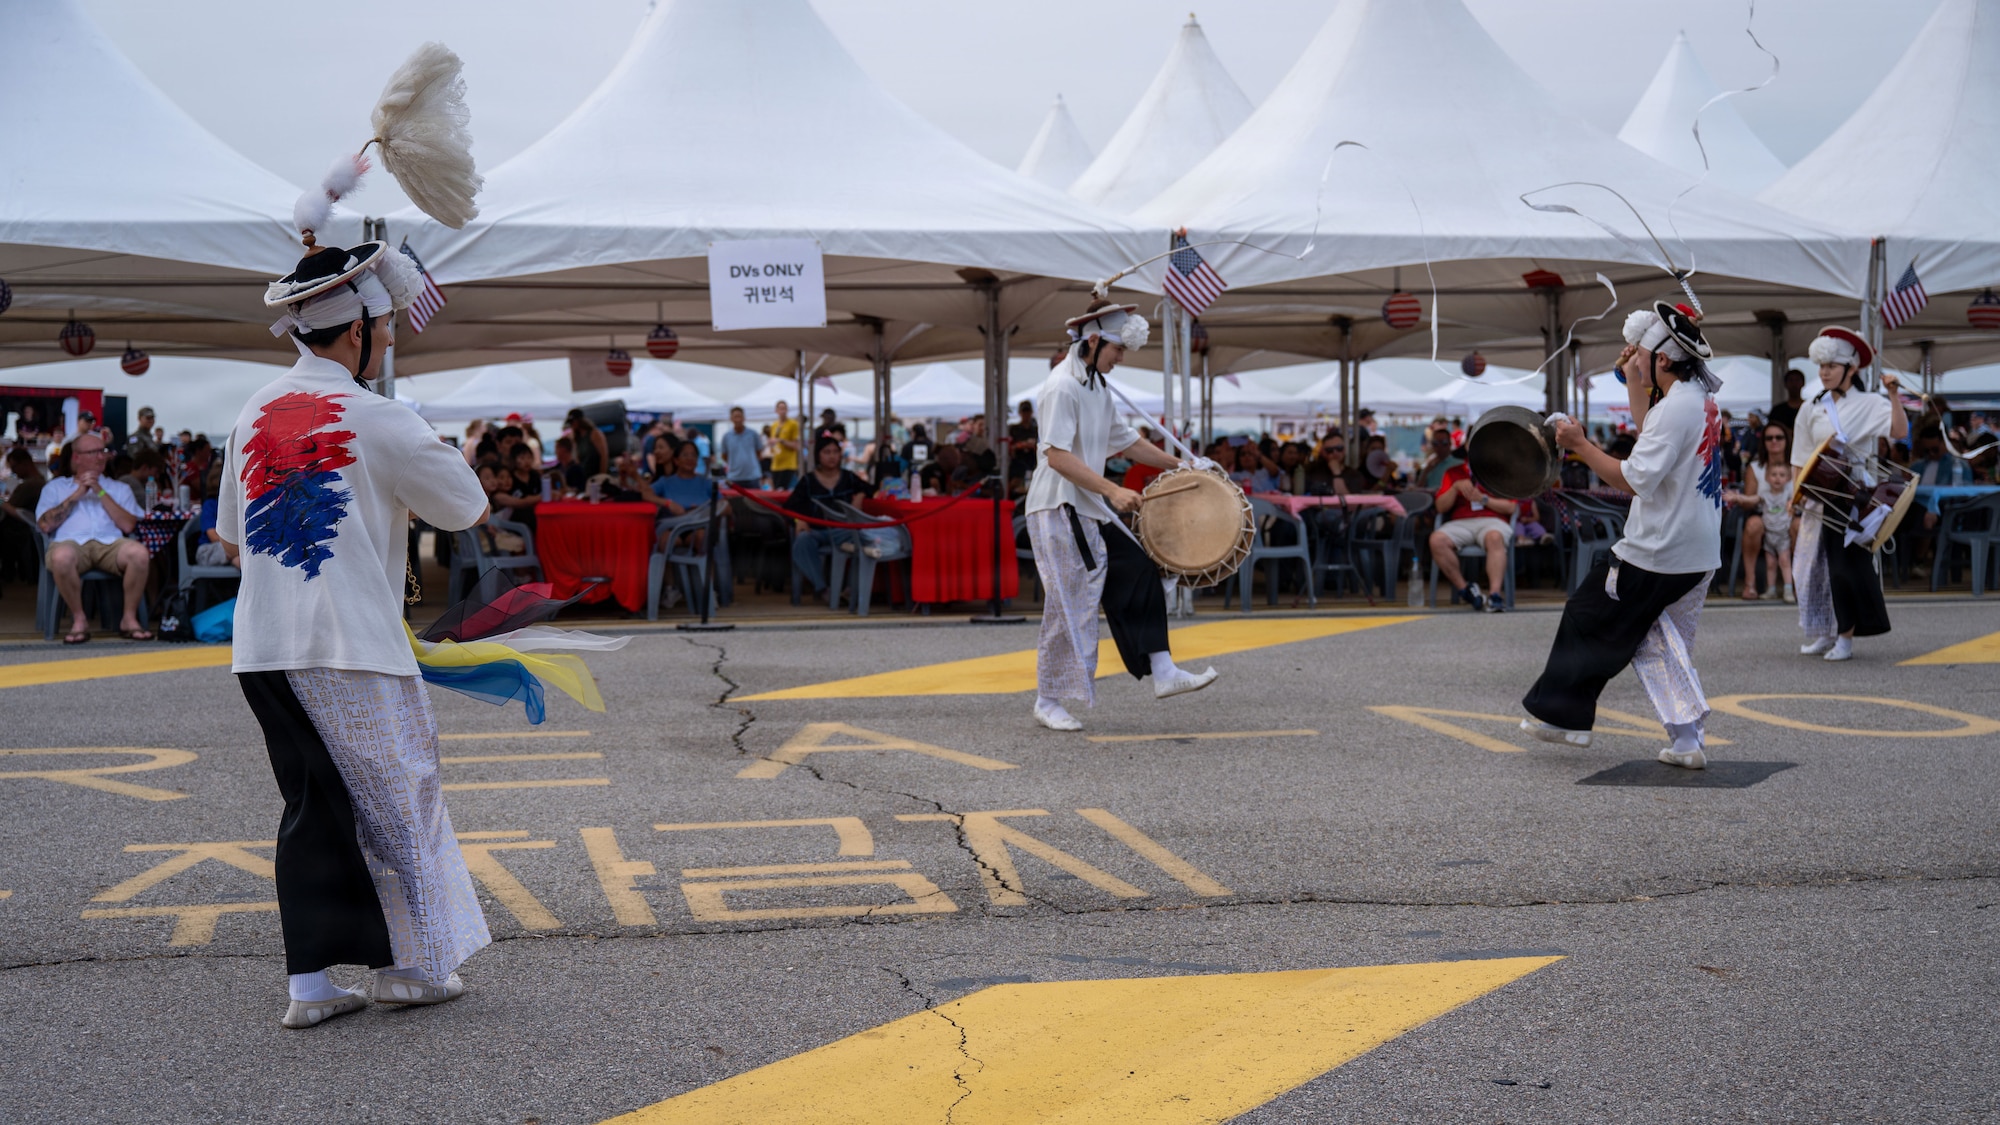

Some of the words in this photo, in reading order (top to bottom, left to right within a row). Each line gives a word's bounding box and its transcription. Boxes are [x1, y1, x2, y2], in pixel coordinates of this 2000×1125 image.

[729, 265, 760, 279] DVs
[763, 263, 804, 277] ONLY
[743, 285, 795, 304] 귀빈석
